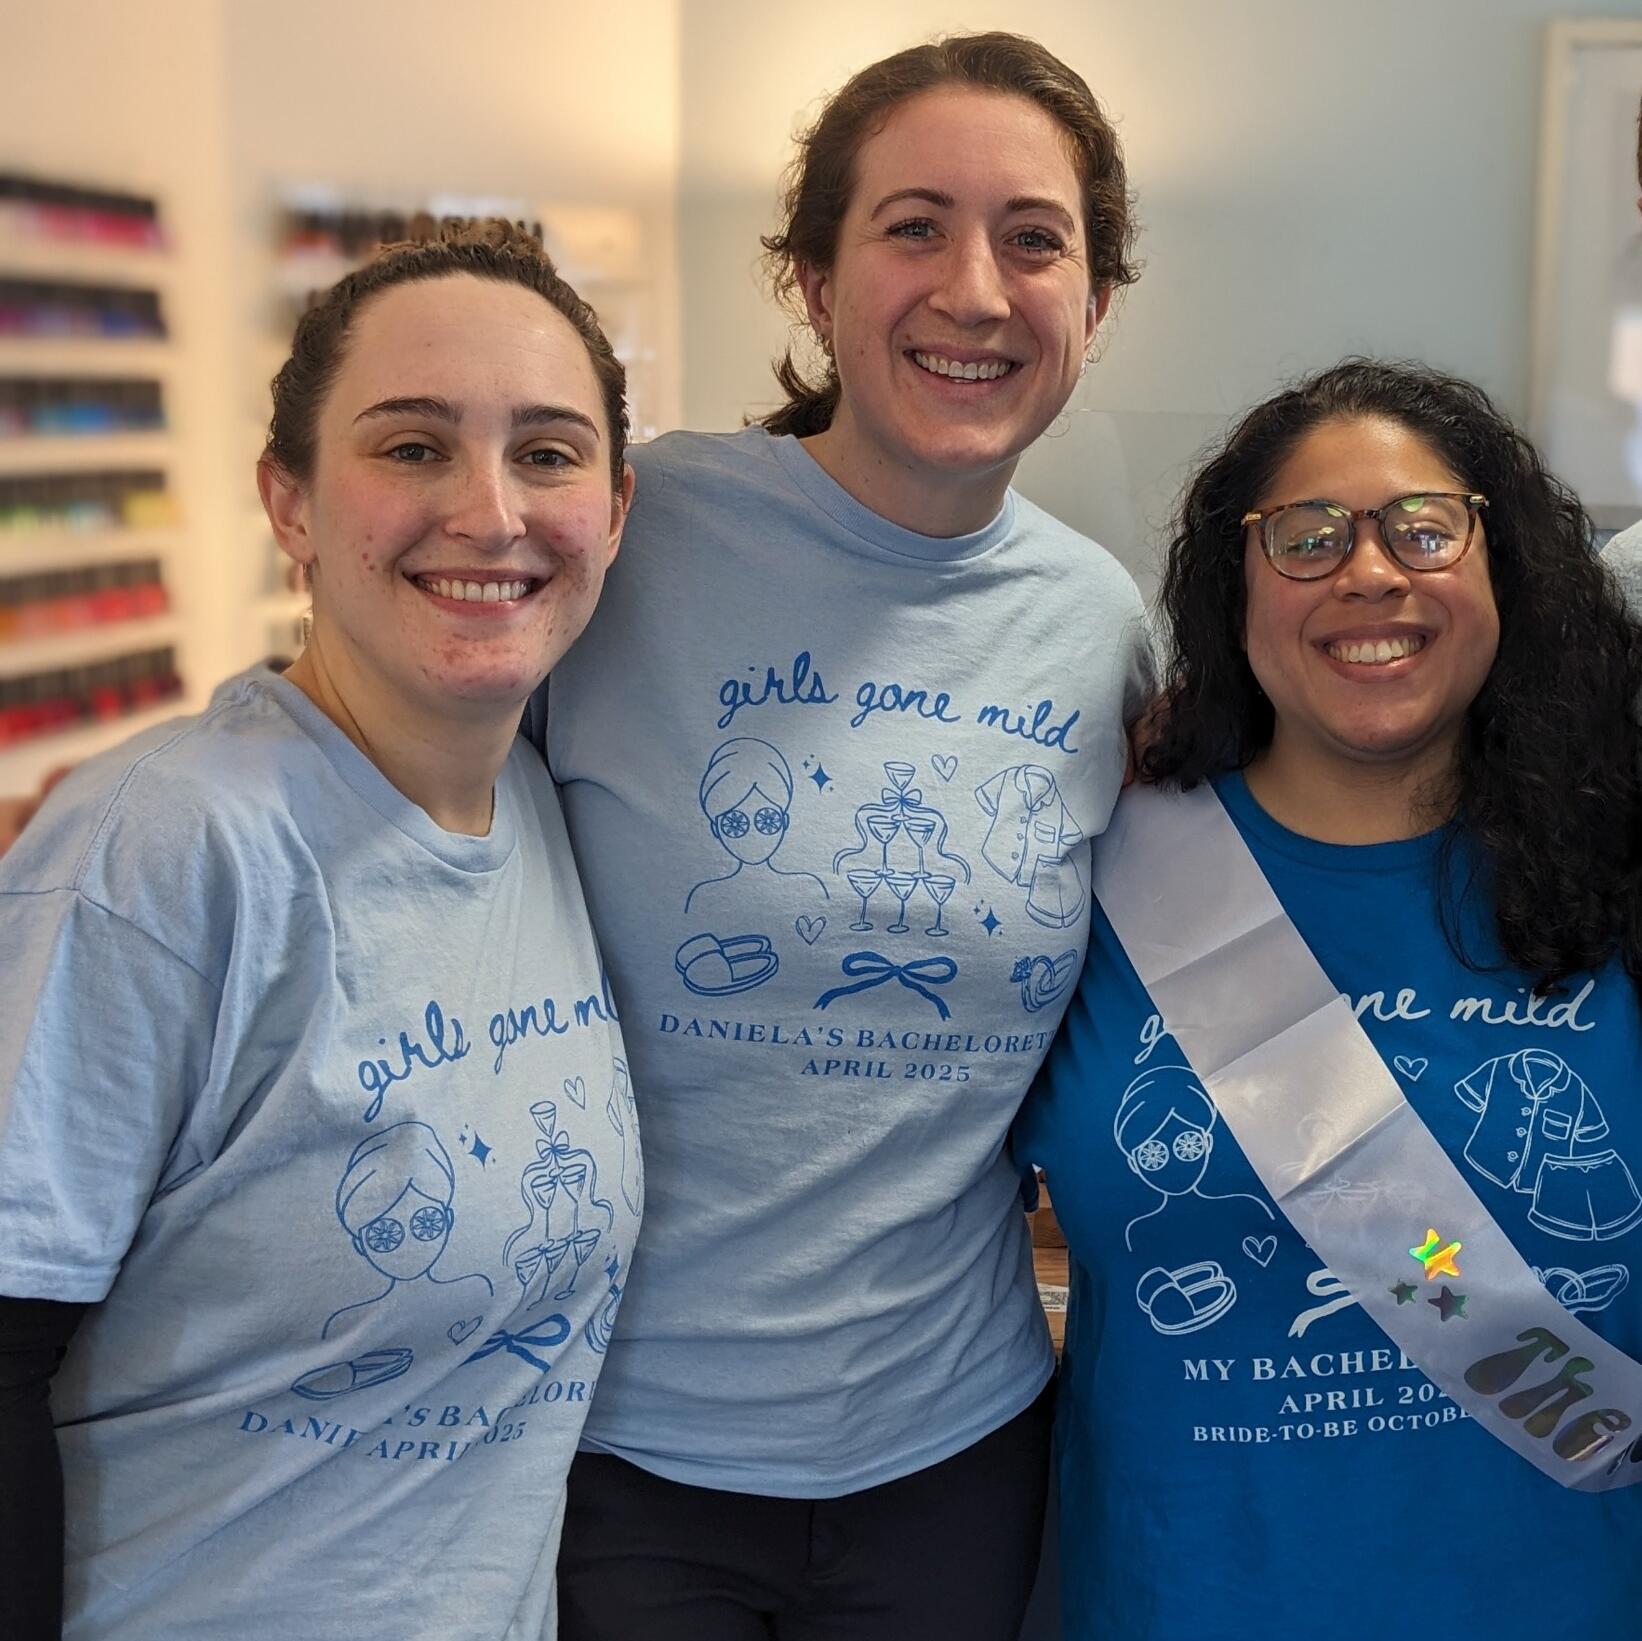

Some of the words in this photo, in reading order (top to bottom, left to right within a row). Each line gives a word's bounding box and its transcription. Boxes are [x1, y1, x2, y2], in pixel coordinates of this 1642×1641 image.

[717, 651, 839, 729] girls
[850, 681, 962, 729] gone
[977, 699, 1080, 755] mild
[1450, 979, 1596, 1032] mild
[657, 1013, 845, 1048] DANIELA'S
[357, 999, 470, 1123] girls
[488, 998, 570, 1075] gone
[800, 1058, 893, 1079] APRIL
[904, 1062, 972, 1083] 2025
[1182, 1358, 1237, 1382] MY
[1251, 1348, 1419, 1381] BACHEL
[1278, 1387, 1385, 1415] APRIL
[1397, 1383, 1448, 1405] 20
[1462, 1326, 1633, 1462] The
[474, 1420, 528, 1452] 025
[1192, 1418, 1359, 1444] BRIDE-TO-BE
[1367, 1406, 1473, 1433] OCTOB
